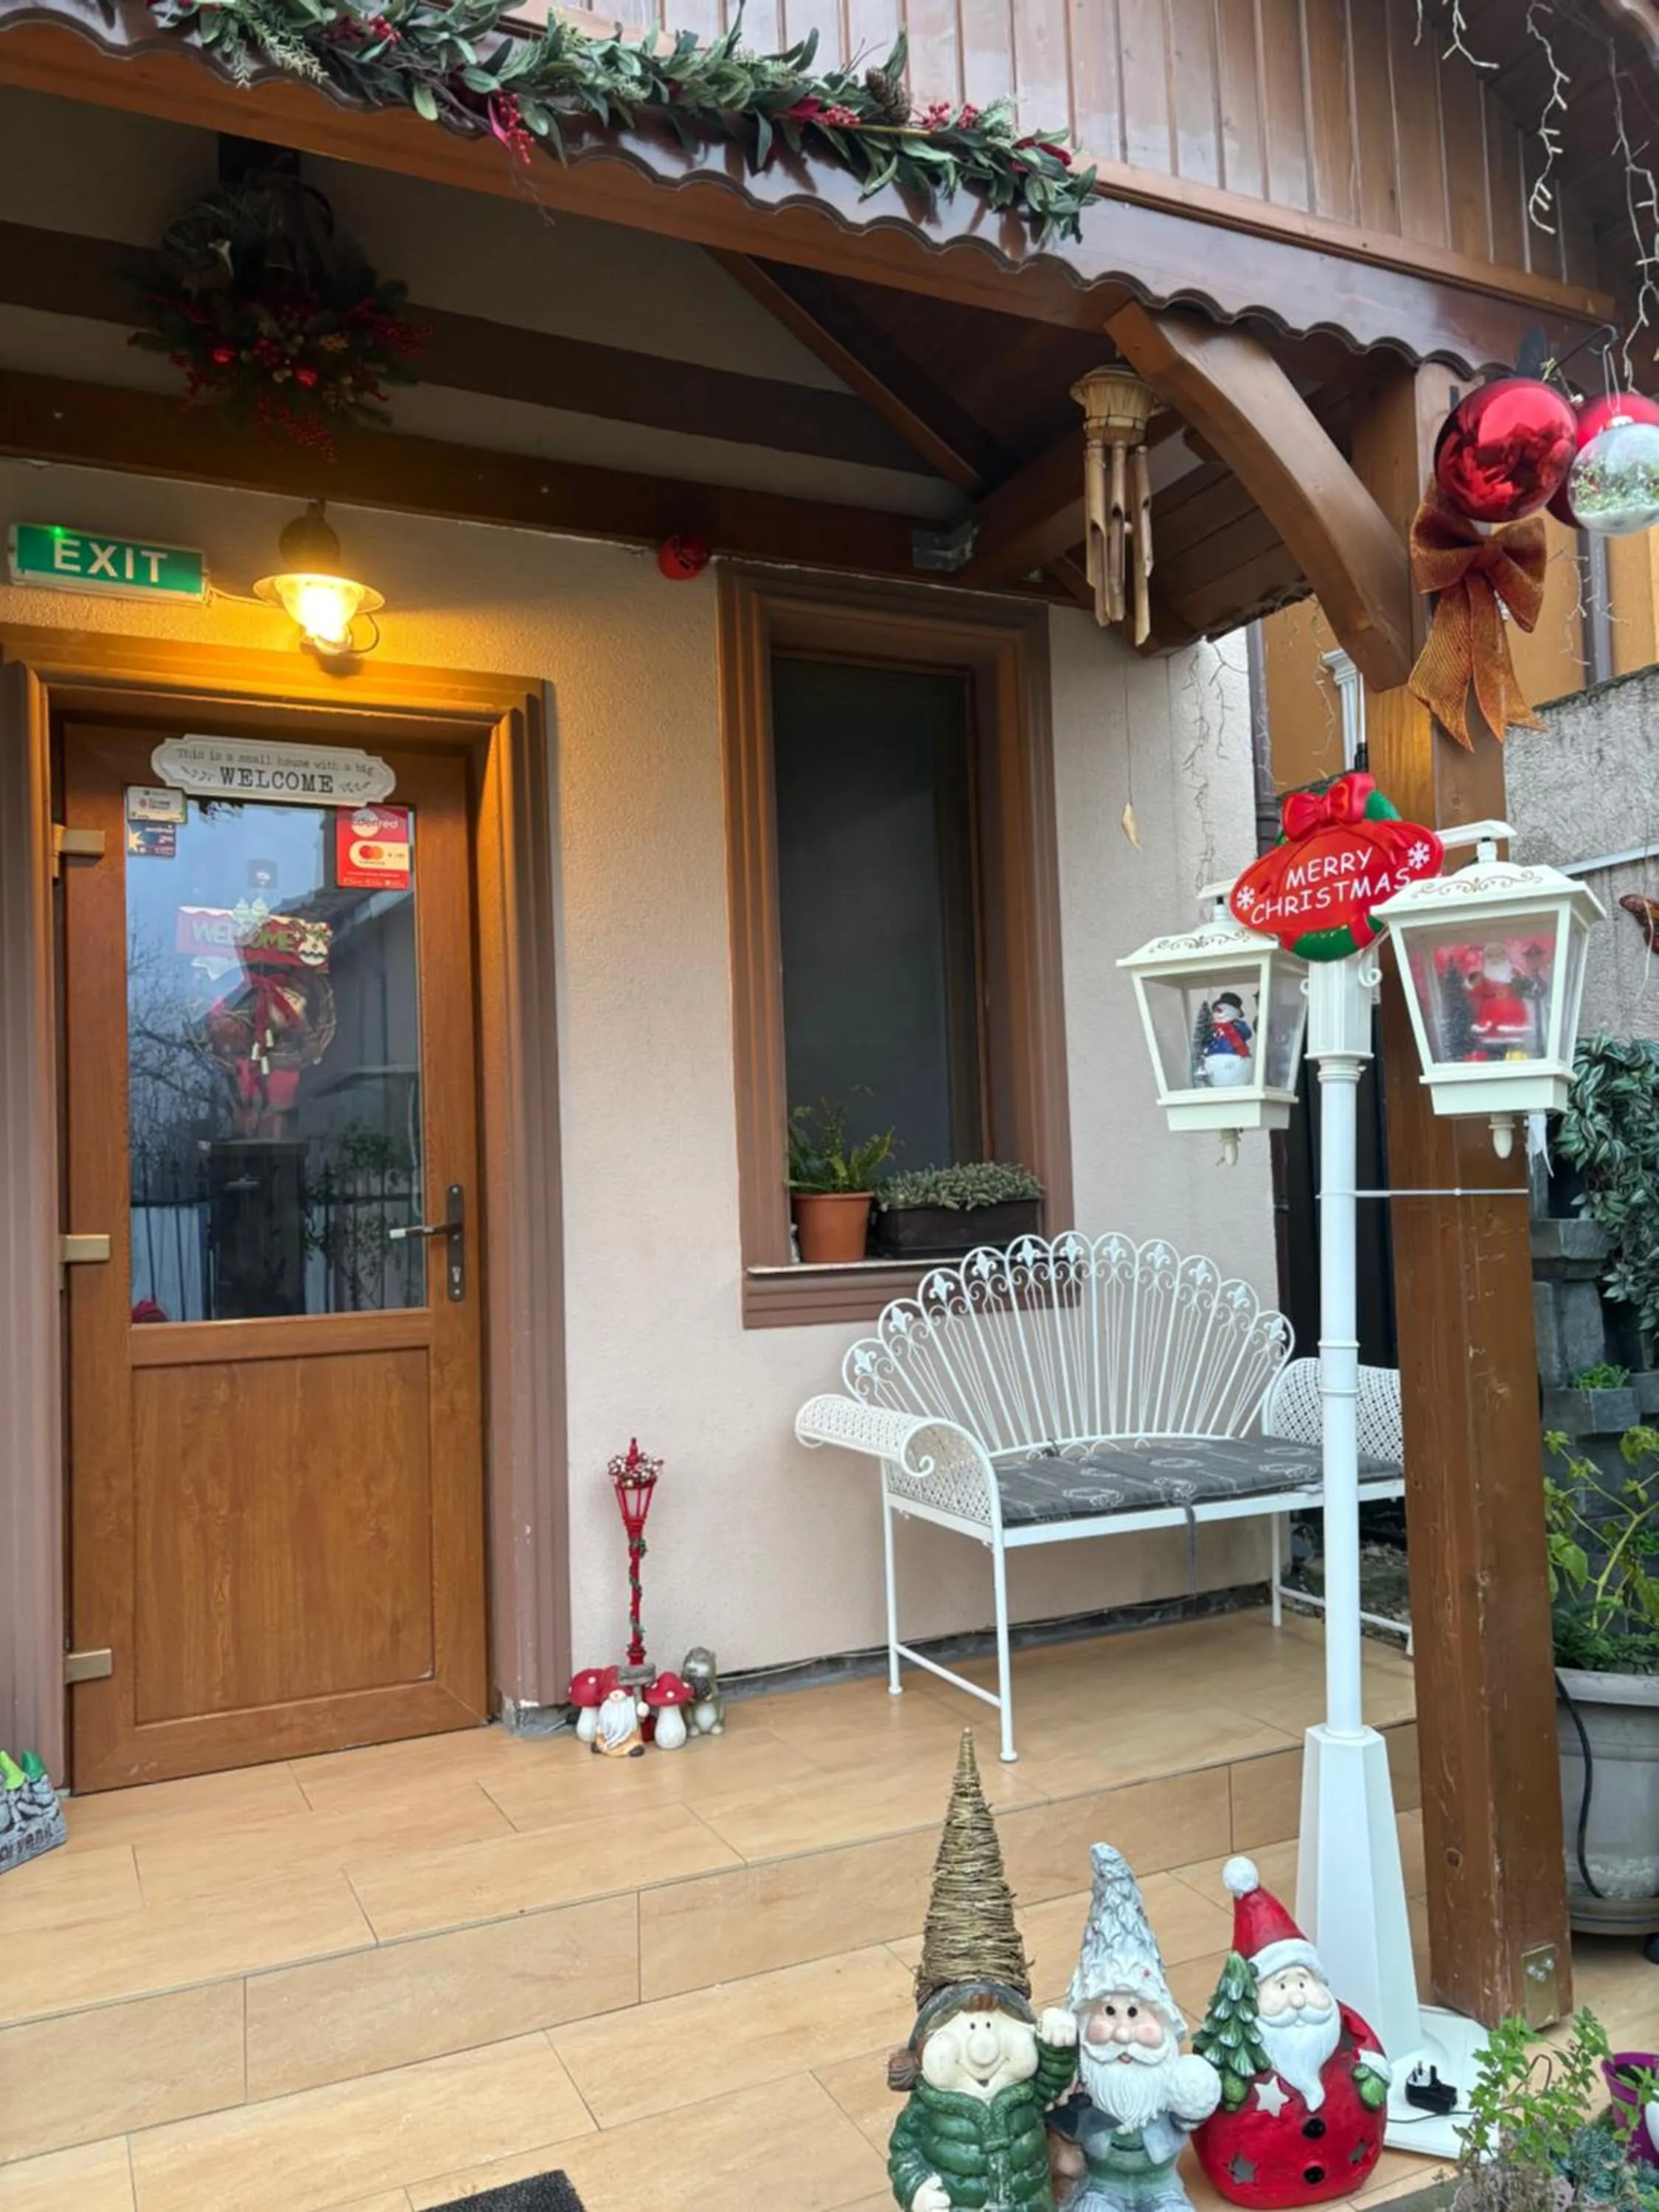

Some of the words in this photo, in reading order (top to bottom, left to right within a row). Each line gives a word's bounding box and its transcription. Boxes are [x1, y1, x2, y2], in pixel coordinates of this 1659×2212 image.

[54, 538, 168, 582] EXIT
[220, 765, 333, 794] WELCOME
[1286, 846, 1373, 890] MERRY
[1251, 867, 1411, 925] CHRISTMAS
